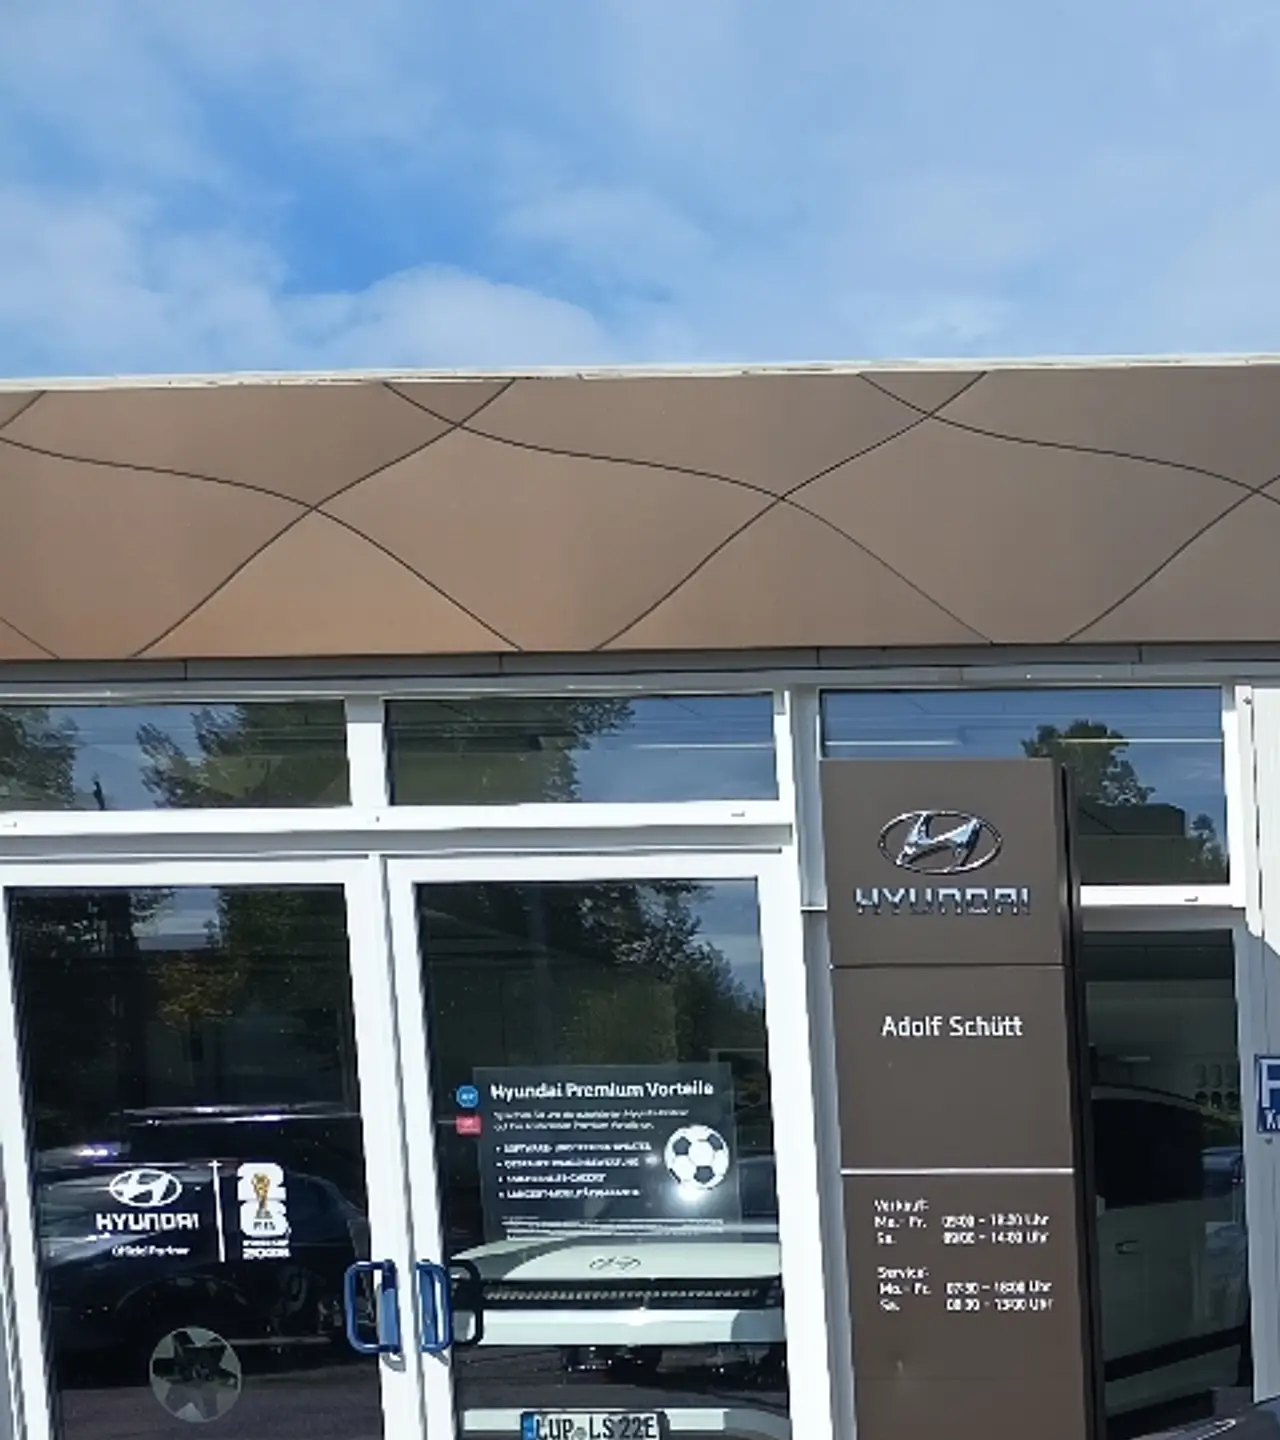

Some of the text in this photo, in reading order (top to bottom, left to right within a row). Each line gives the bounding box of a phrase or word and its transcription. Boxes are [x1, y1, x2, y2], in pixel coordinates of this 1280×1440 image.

[855, 887, 1029, 914] HYUNDAI
[881, 1015, 1023, 1037] Adolf Schütt
[490, 1082, 563, 1102] Hyundai
[565, 1082, 644, 1099] Premium
[648, 1080, 714, 1097] Vorteile
[95, 1212, 200, 1231] HYUNDAI
[1025, 1213, 1049, 1226] Uhr
[1026, 1230, 1049, 1243] Uhr
[1029, 1280, 1052, 1292] Uhr
